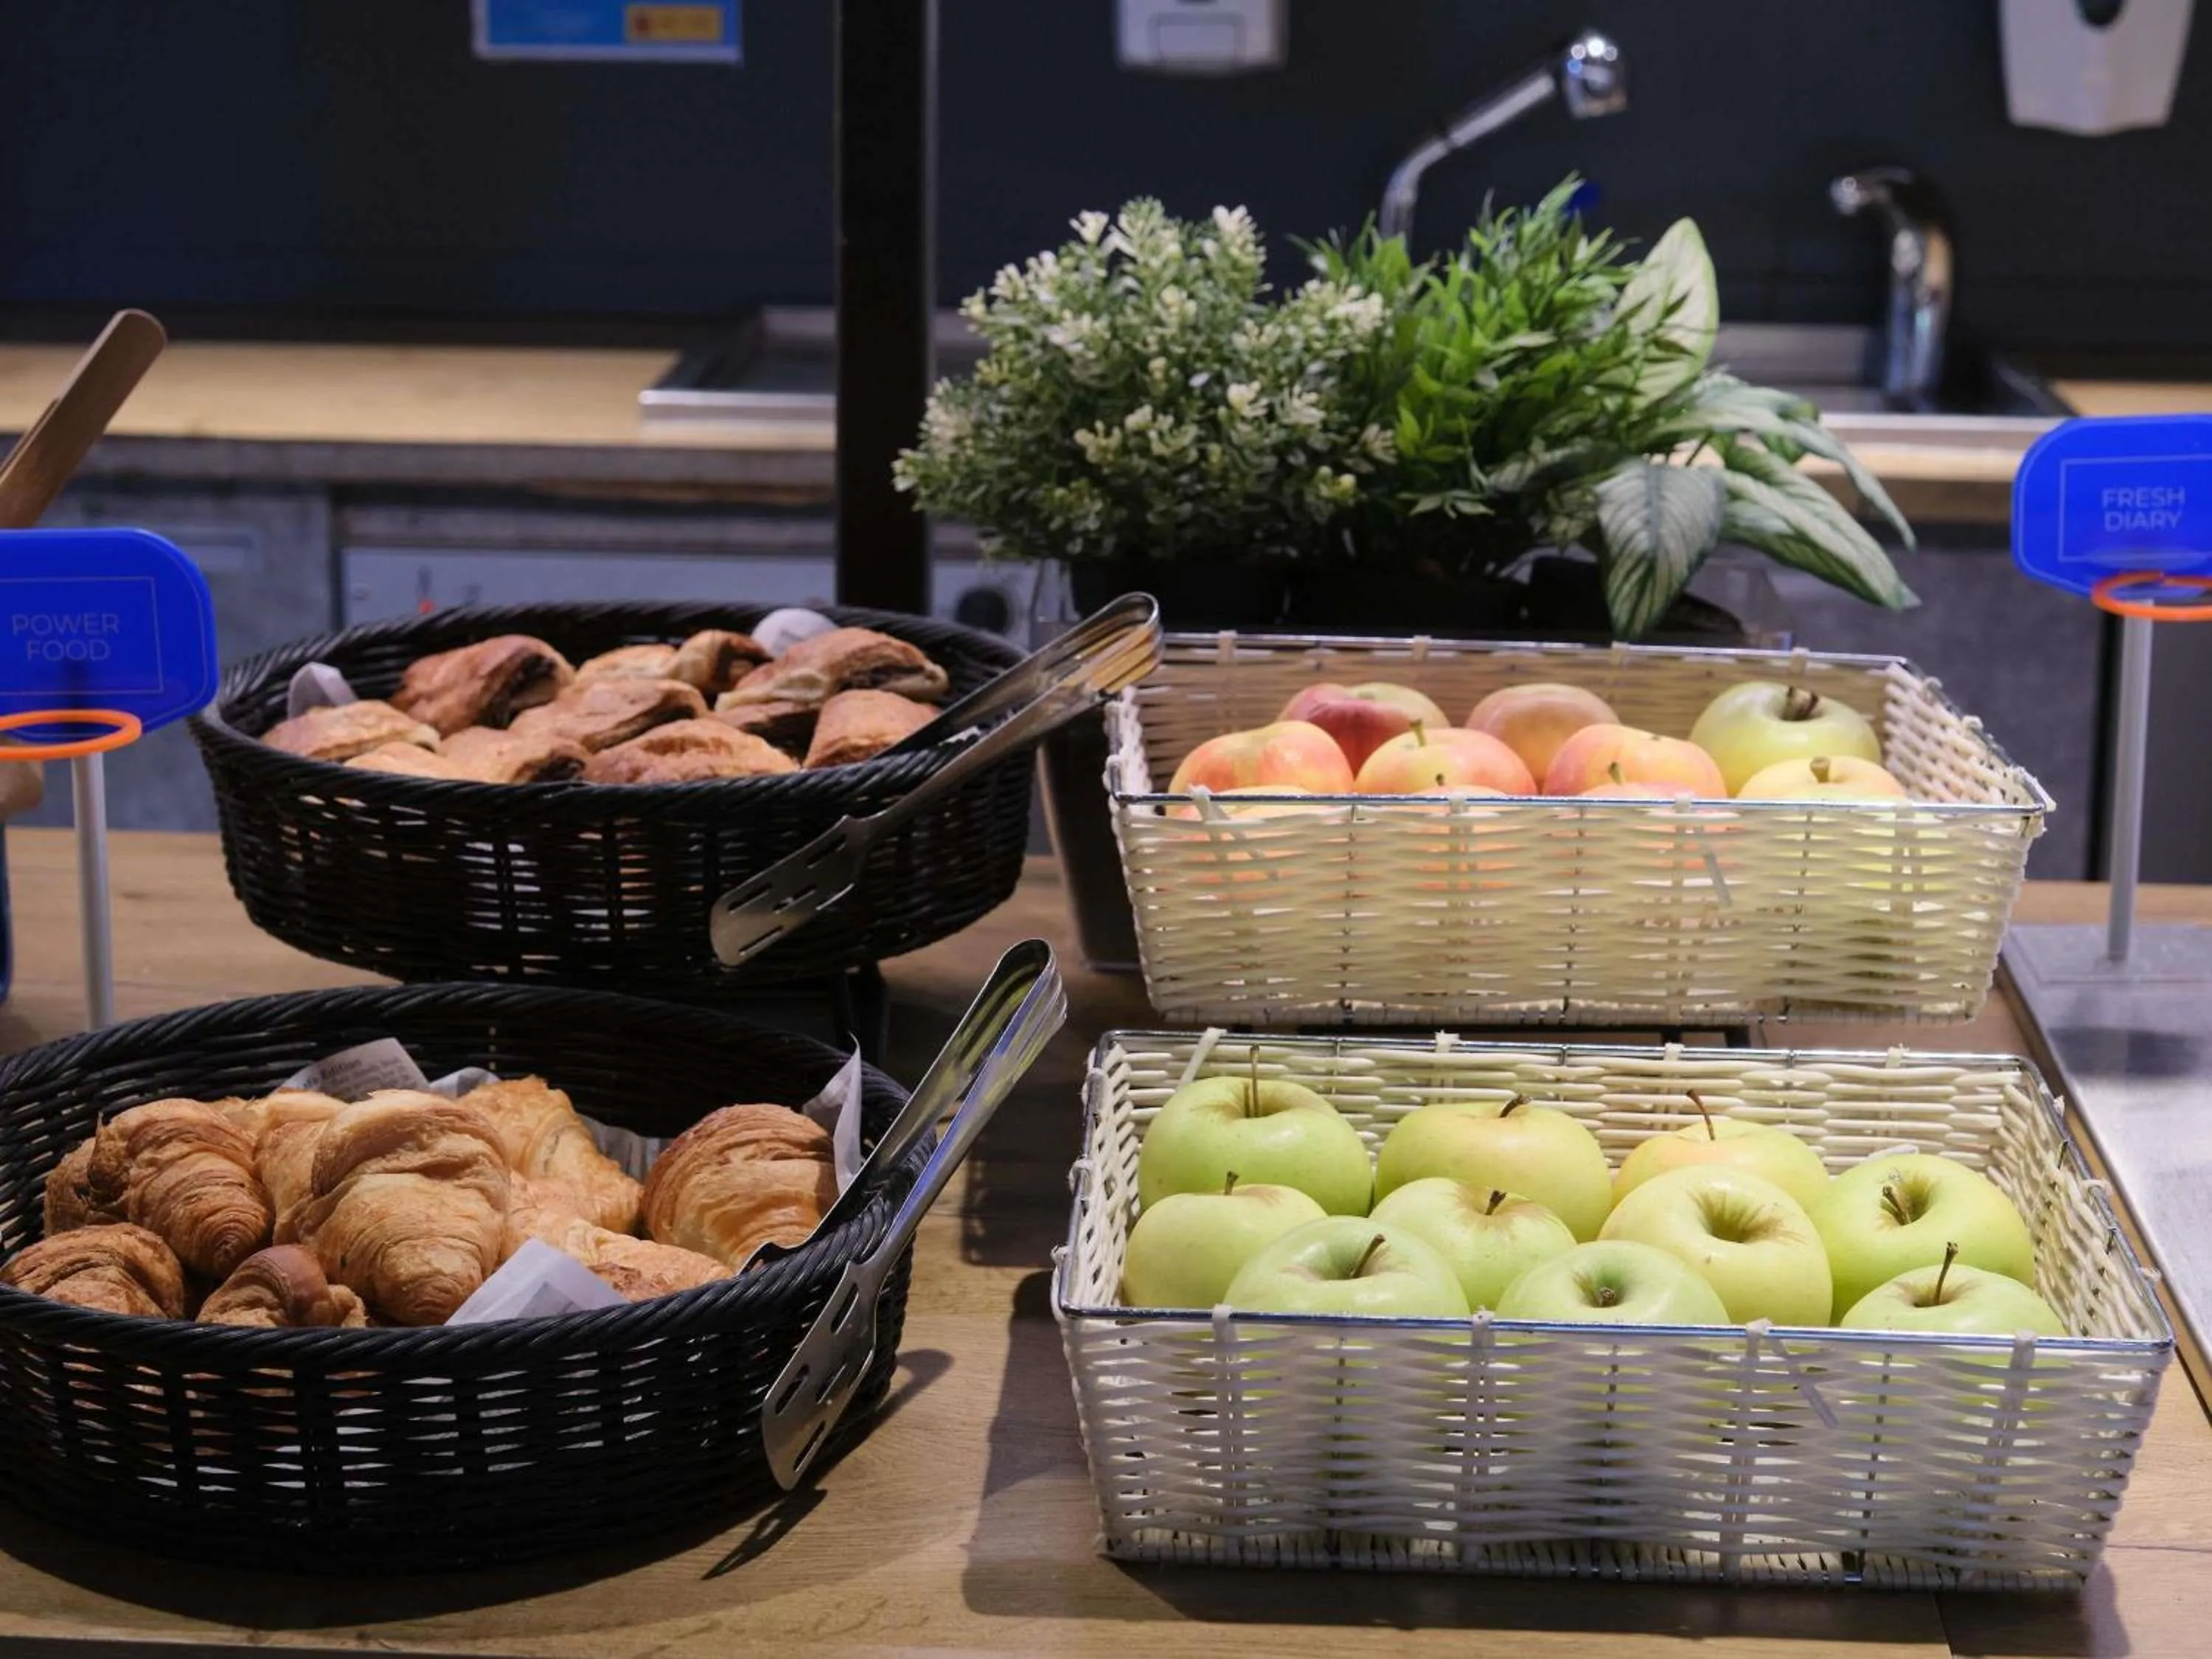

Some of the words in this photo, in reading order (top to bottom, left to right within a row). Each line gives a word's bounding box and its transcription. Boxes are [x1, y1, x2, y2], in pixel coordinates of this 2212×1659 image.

[2103, 487, 2185, 508] FRESH
[2104, 509, 2183, 532] DIARY
[13, 613, 119, 636] POWER
[27, 639, 110, 661] FOOD
